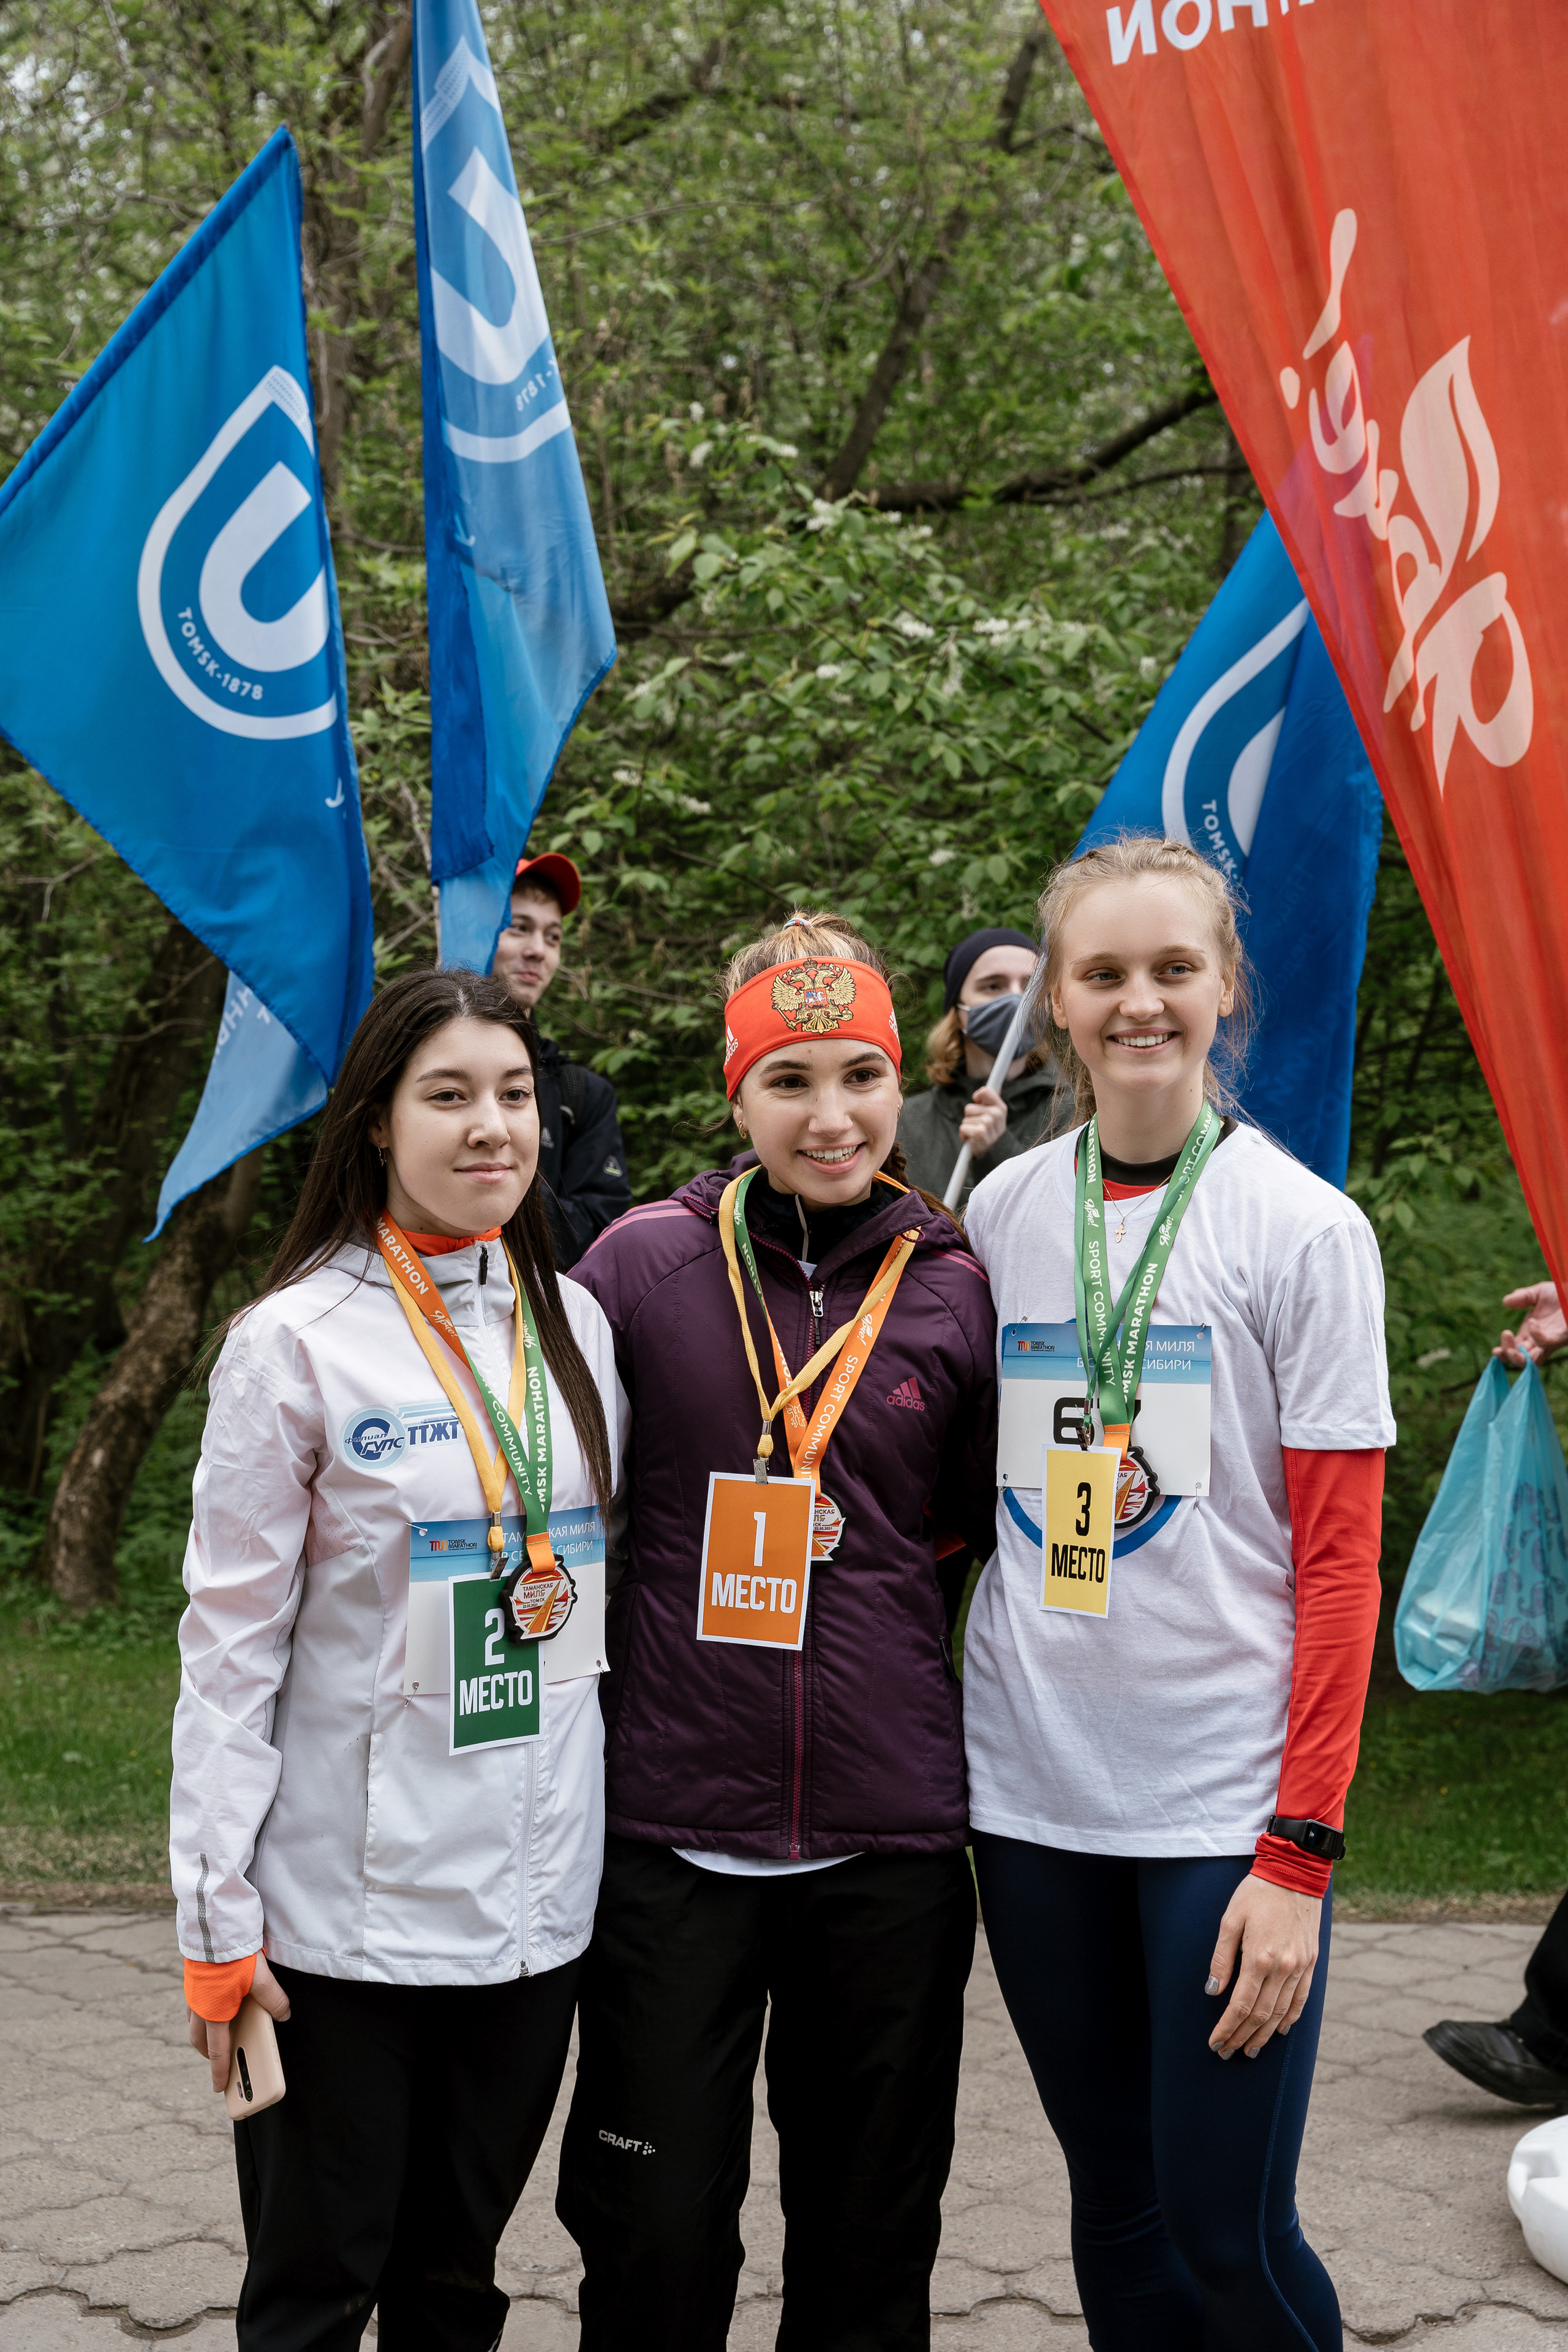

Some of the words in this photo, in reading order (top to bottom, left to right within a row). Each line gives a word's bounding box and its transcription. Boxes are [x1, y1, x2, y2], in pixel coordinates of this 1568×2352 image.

[1087, 1116, 1096, 1183] ARATHON
[376, 1217, 429, 1295] MARATHON
[1088, 1241, 1102, 1286] SPORT
[1126, 1263, 1158, 1354] MARATHON
[1156, 1341, 1194, 1352] МИЛЯ
[830, 1354, 859, 1402] SPORT
[1123, 1359, 1135, 1403] MSK
[527, 1366, 547, 1462] MARATHON
[886, 1394, 925, 1411] adidas
[345, 1433, 387, 1445] филиал
[407, 1420, 459, 1446] ТТЖТ
[492, 1400, 532, 1496] COMMUNITY
[800, 1404, 835, 1480] COMMUNIT
[537, 1466, 547, 1513] MSK
[1075, 1482, 1092, 1536] 3
[503, 1526, 567, 1544] ТАМКАЯ
[570, 1521, 595, 1536] МИЛЯ
[557, 1540, 593, 1555] СИБИРИ
[753, 1511, 766, 1567] 1
[1050, 1542, 1105, 1584] МЕСТО
[522, 1583, 554, 1591] ТАМАНСКАЯ
[524, 1589, 545, 1599] МИЛЯ
[711, 1572, 797, 1613] МЕСТО
[485, 1608, 505, 1666] 2
[459, 1670, 532, 1716] МЕСТО
[598, 2130, 643, 2152] CRAFT
